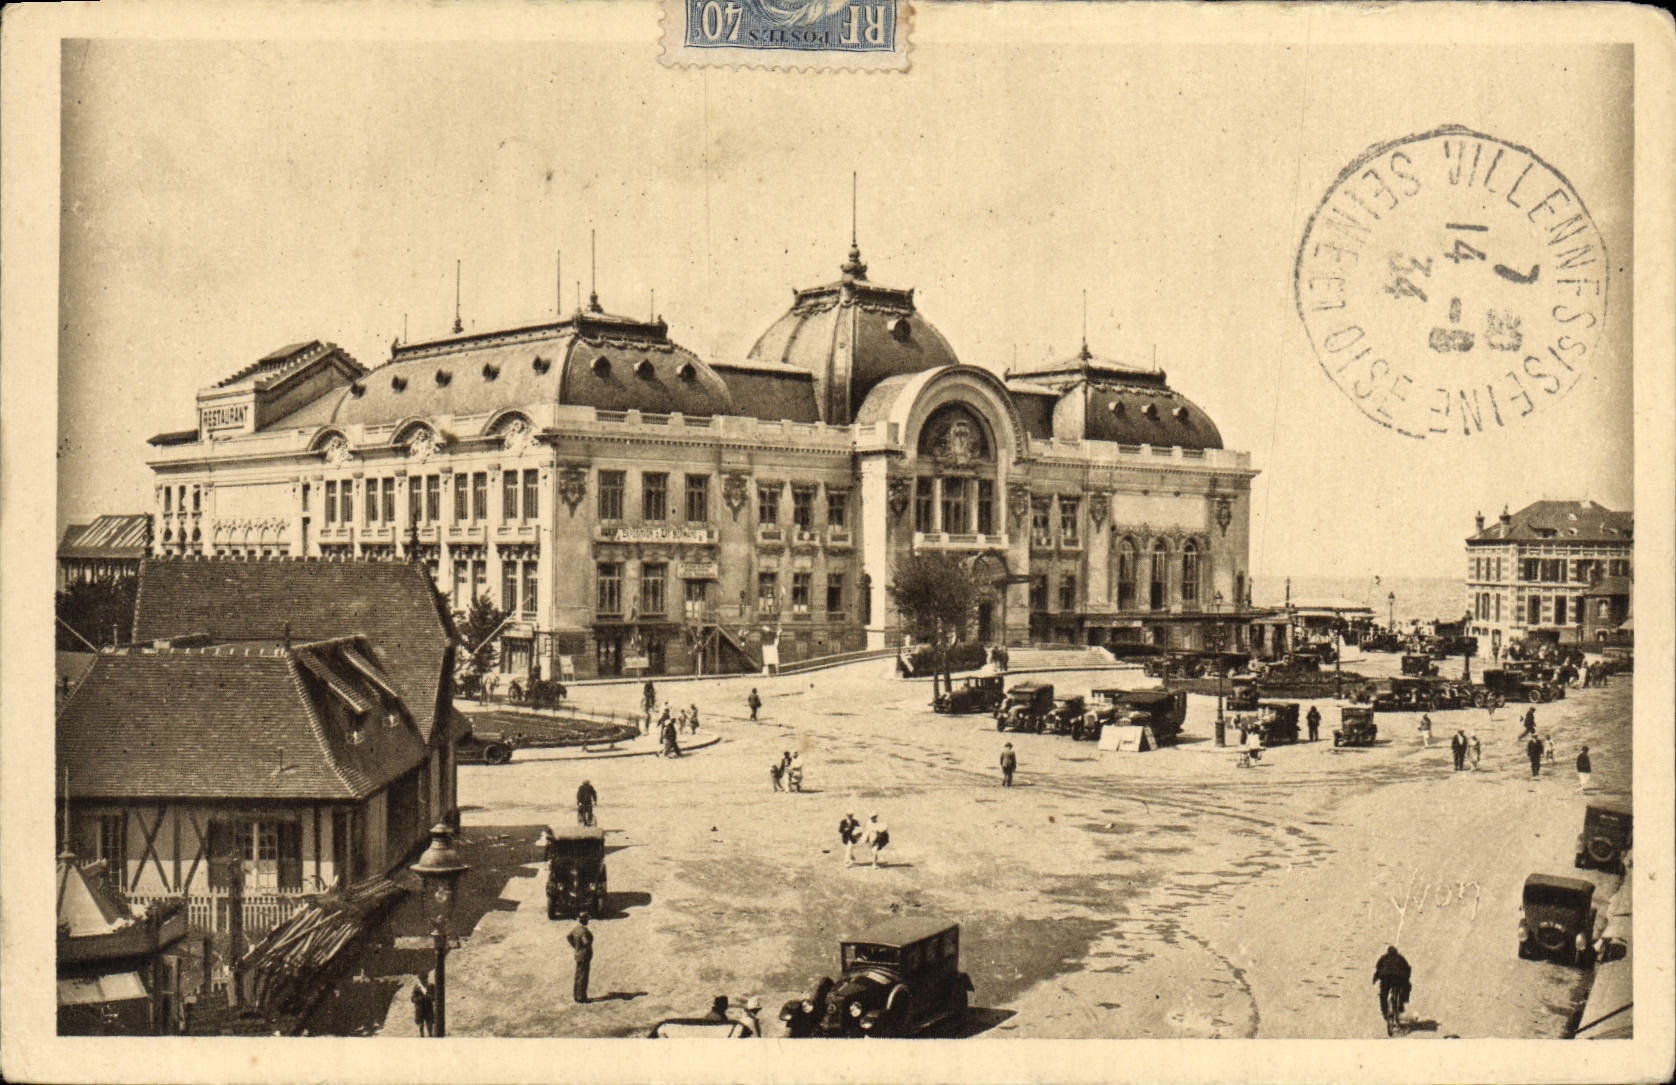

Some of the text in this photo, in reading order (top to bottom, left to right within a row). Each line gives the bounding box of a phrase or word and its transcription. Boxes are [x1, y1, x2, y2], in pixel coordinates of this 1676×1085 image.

[749, 28, 831, 44] POSTES
[839, 4, 886, 45] RF
[202, 405, 249, 428] RESTAURANT
